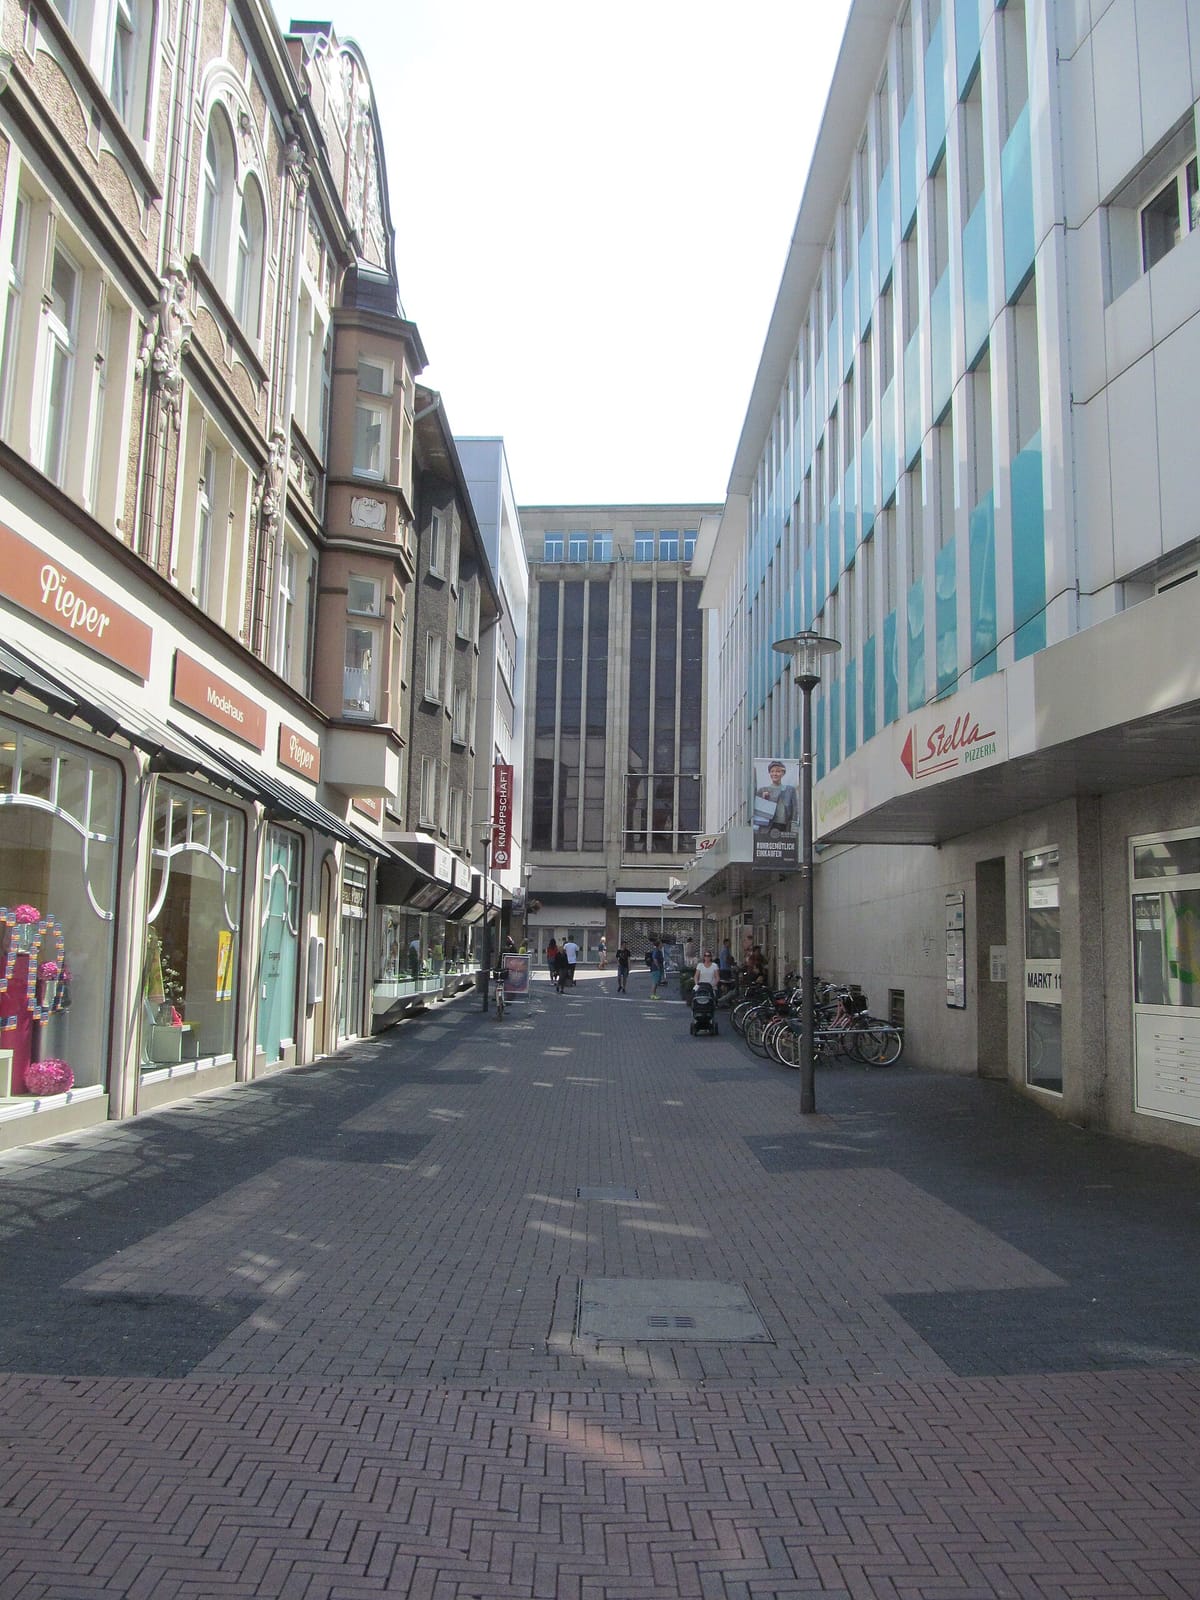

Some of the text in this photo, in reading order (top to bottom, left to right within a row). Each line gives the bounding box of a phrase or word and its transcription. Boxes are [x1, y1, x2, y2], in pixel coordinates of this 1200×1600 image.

[40, 564, 111, 638] Pieper
[207, 686, 244, 723] Modehaus
[289, 734, 315, 769] Pieper
[918, 712, 996, 763] Stella
[964, 742, 996, 763] PIZZERIA
[498, 770, 508, 847] KNAPPSCHAFT
[1027, 972, 1062, 989] MARKT 11
